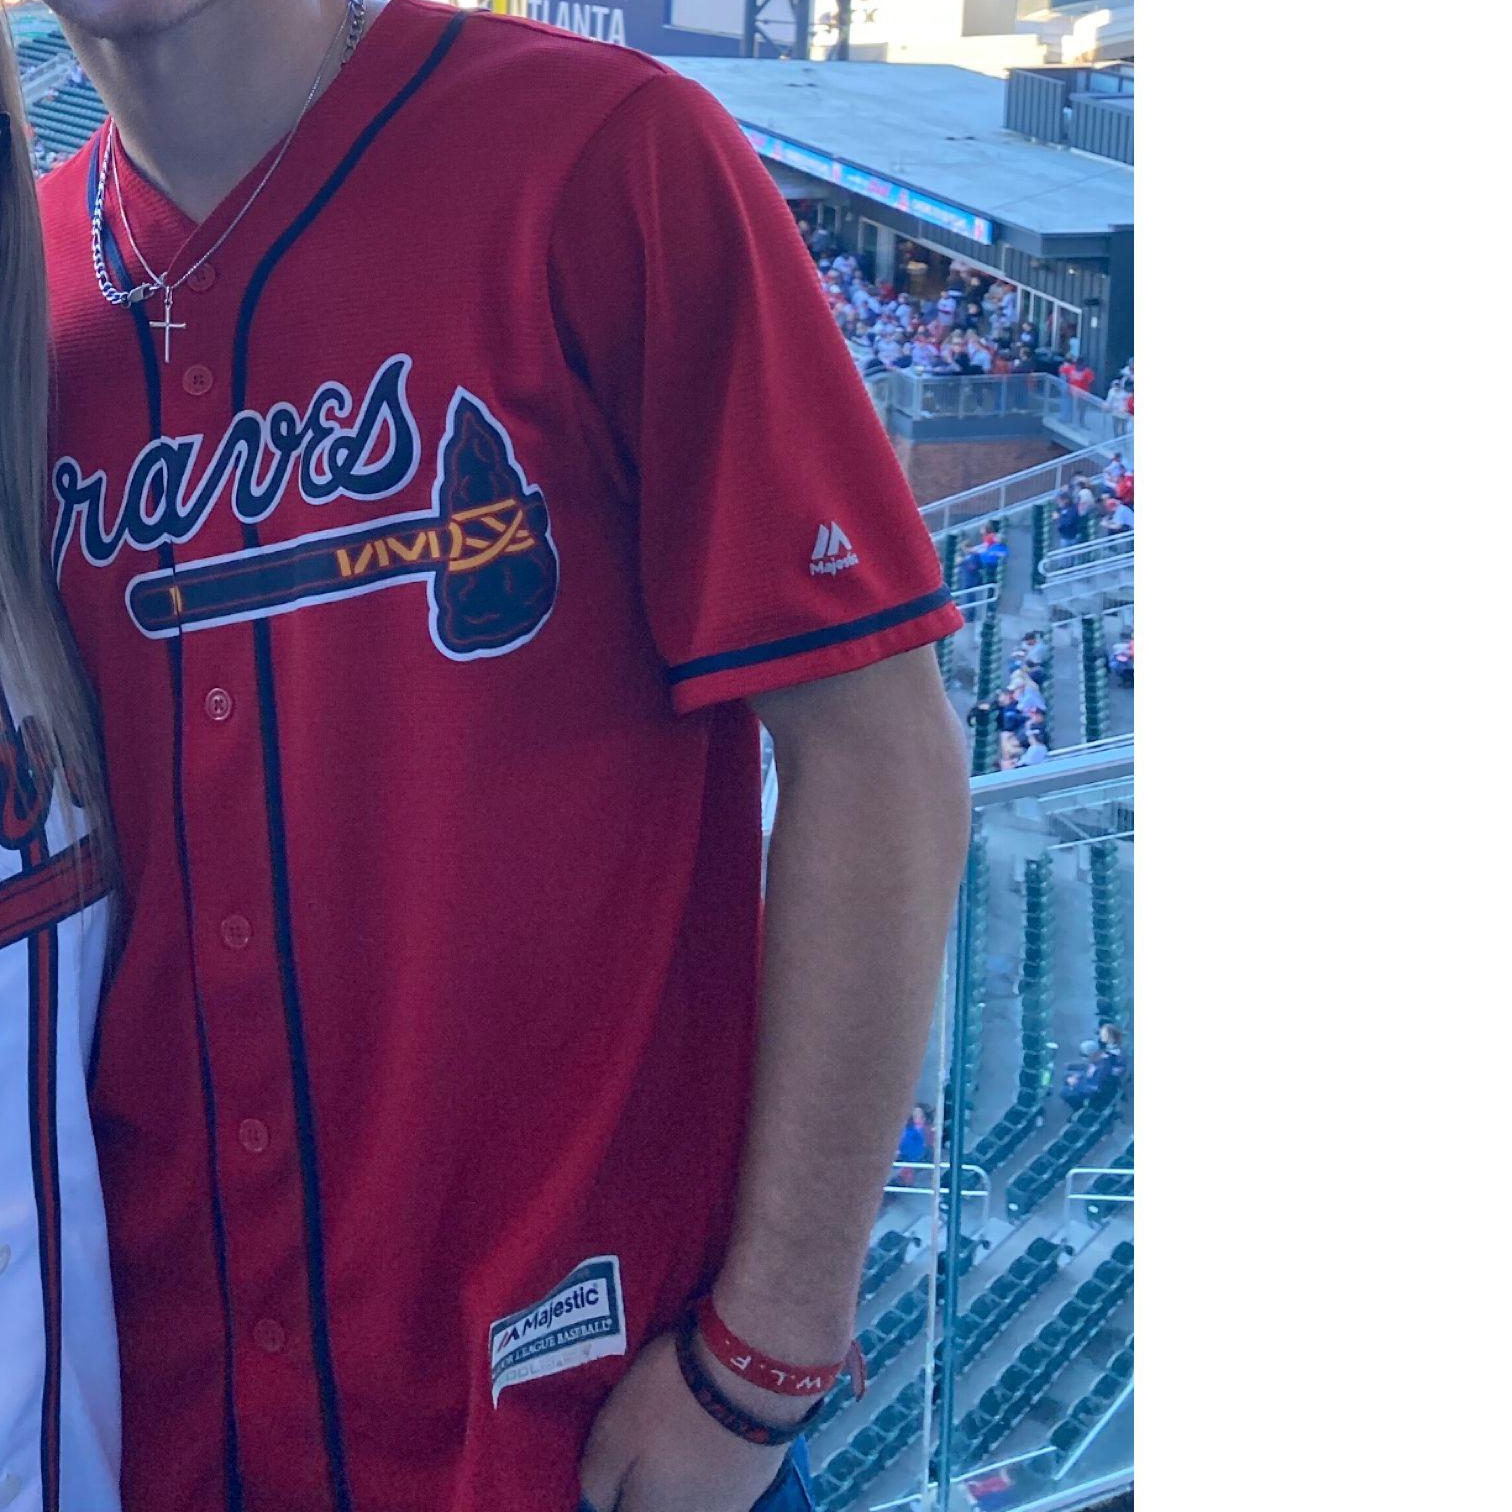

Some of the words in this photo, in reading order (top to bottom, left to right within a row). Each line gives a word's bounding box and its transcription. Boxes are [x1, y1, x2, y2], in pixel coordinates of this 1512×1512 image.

[522, 1286, 599, 1337] Majestic
[514, 1336, 556, 1361] LEAGUE
[556, 1322, 609, 1344] BASEBALL
